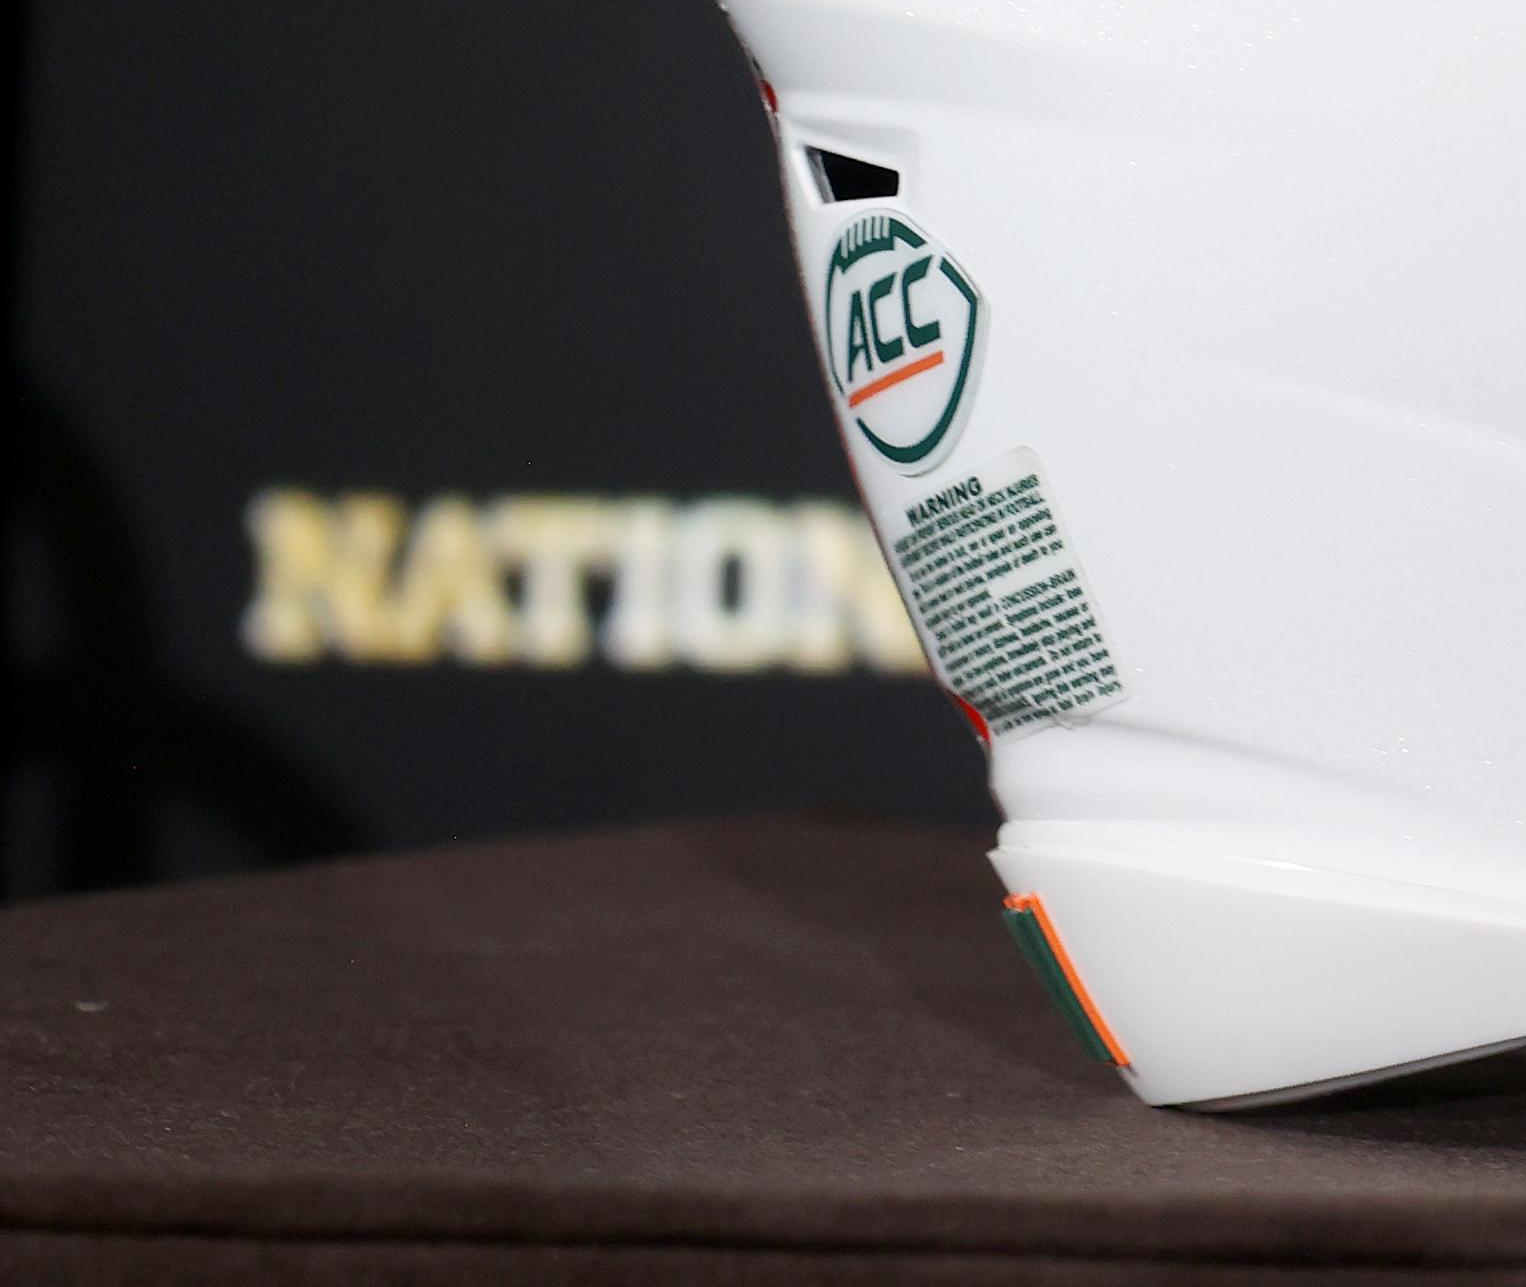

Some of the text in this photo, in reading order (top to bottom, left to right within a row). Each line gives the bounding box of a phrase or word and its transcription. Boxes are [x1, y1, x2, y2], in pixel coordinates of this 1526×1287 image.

[848, 253, 941, 383] ACC
[906, 476, 983, 528] WARNING
[243, 489, 936, 670] NATION
